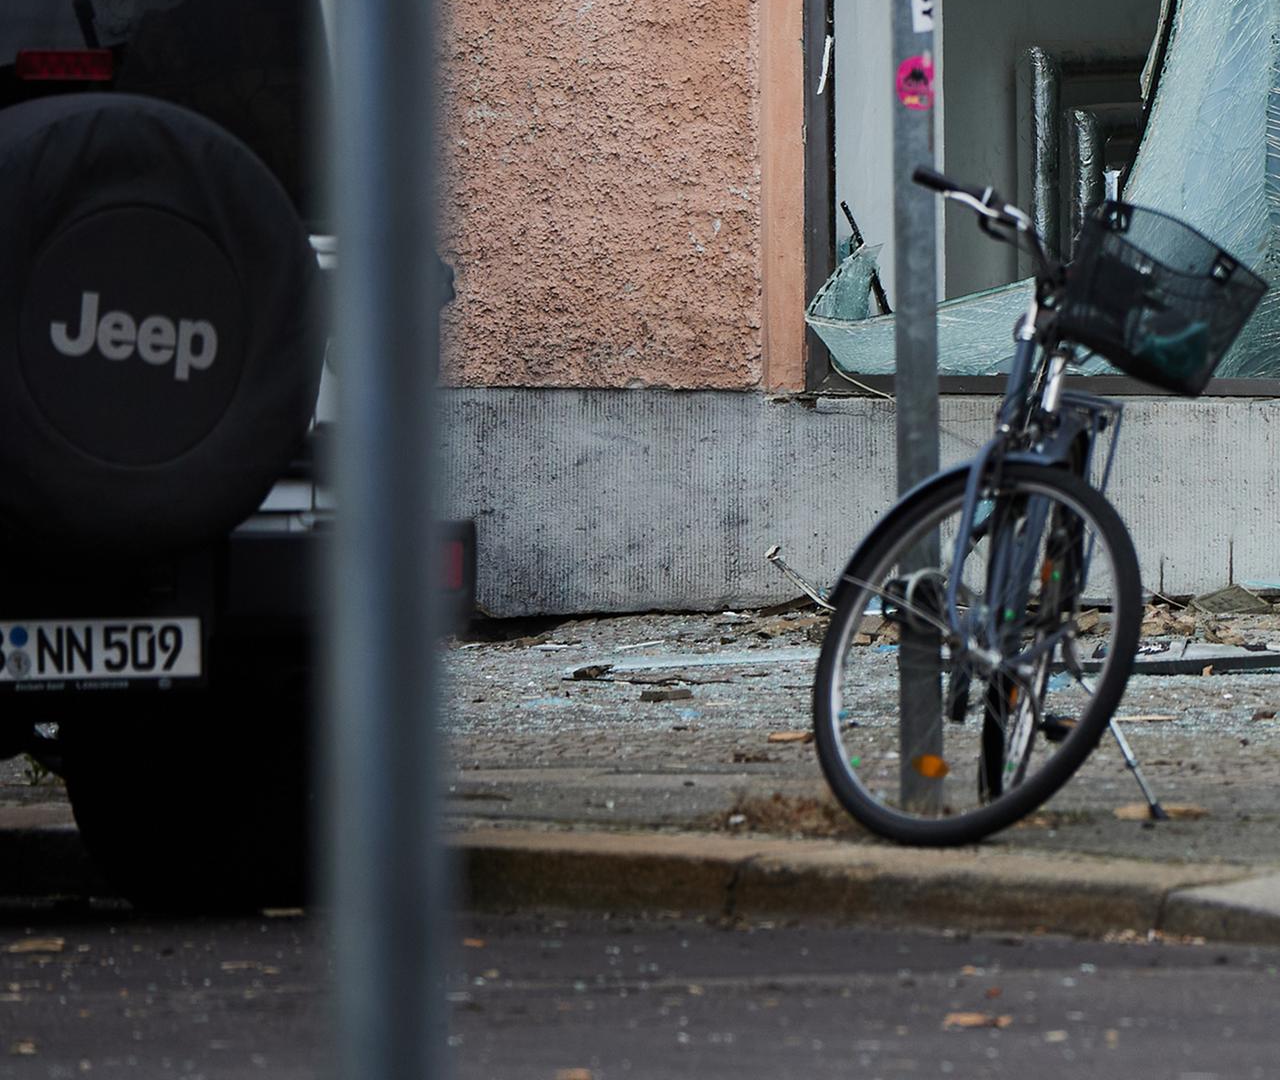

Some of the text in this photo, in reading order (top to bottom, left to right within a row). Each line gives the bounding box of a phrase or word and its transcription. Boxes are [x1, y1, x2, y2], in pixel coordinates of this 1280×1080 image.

[50, 291, 218, 381] Jeep
[37, 625, 93, 674] NN
[103, 624, 183, 672] 509
